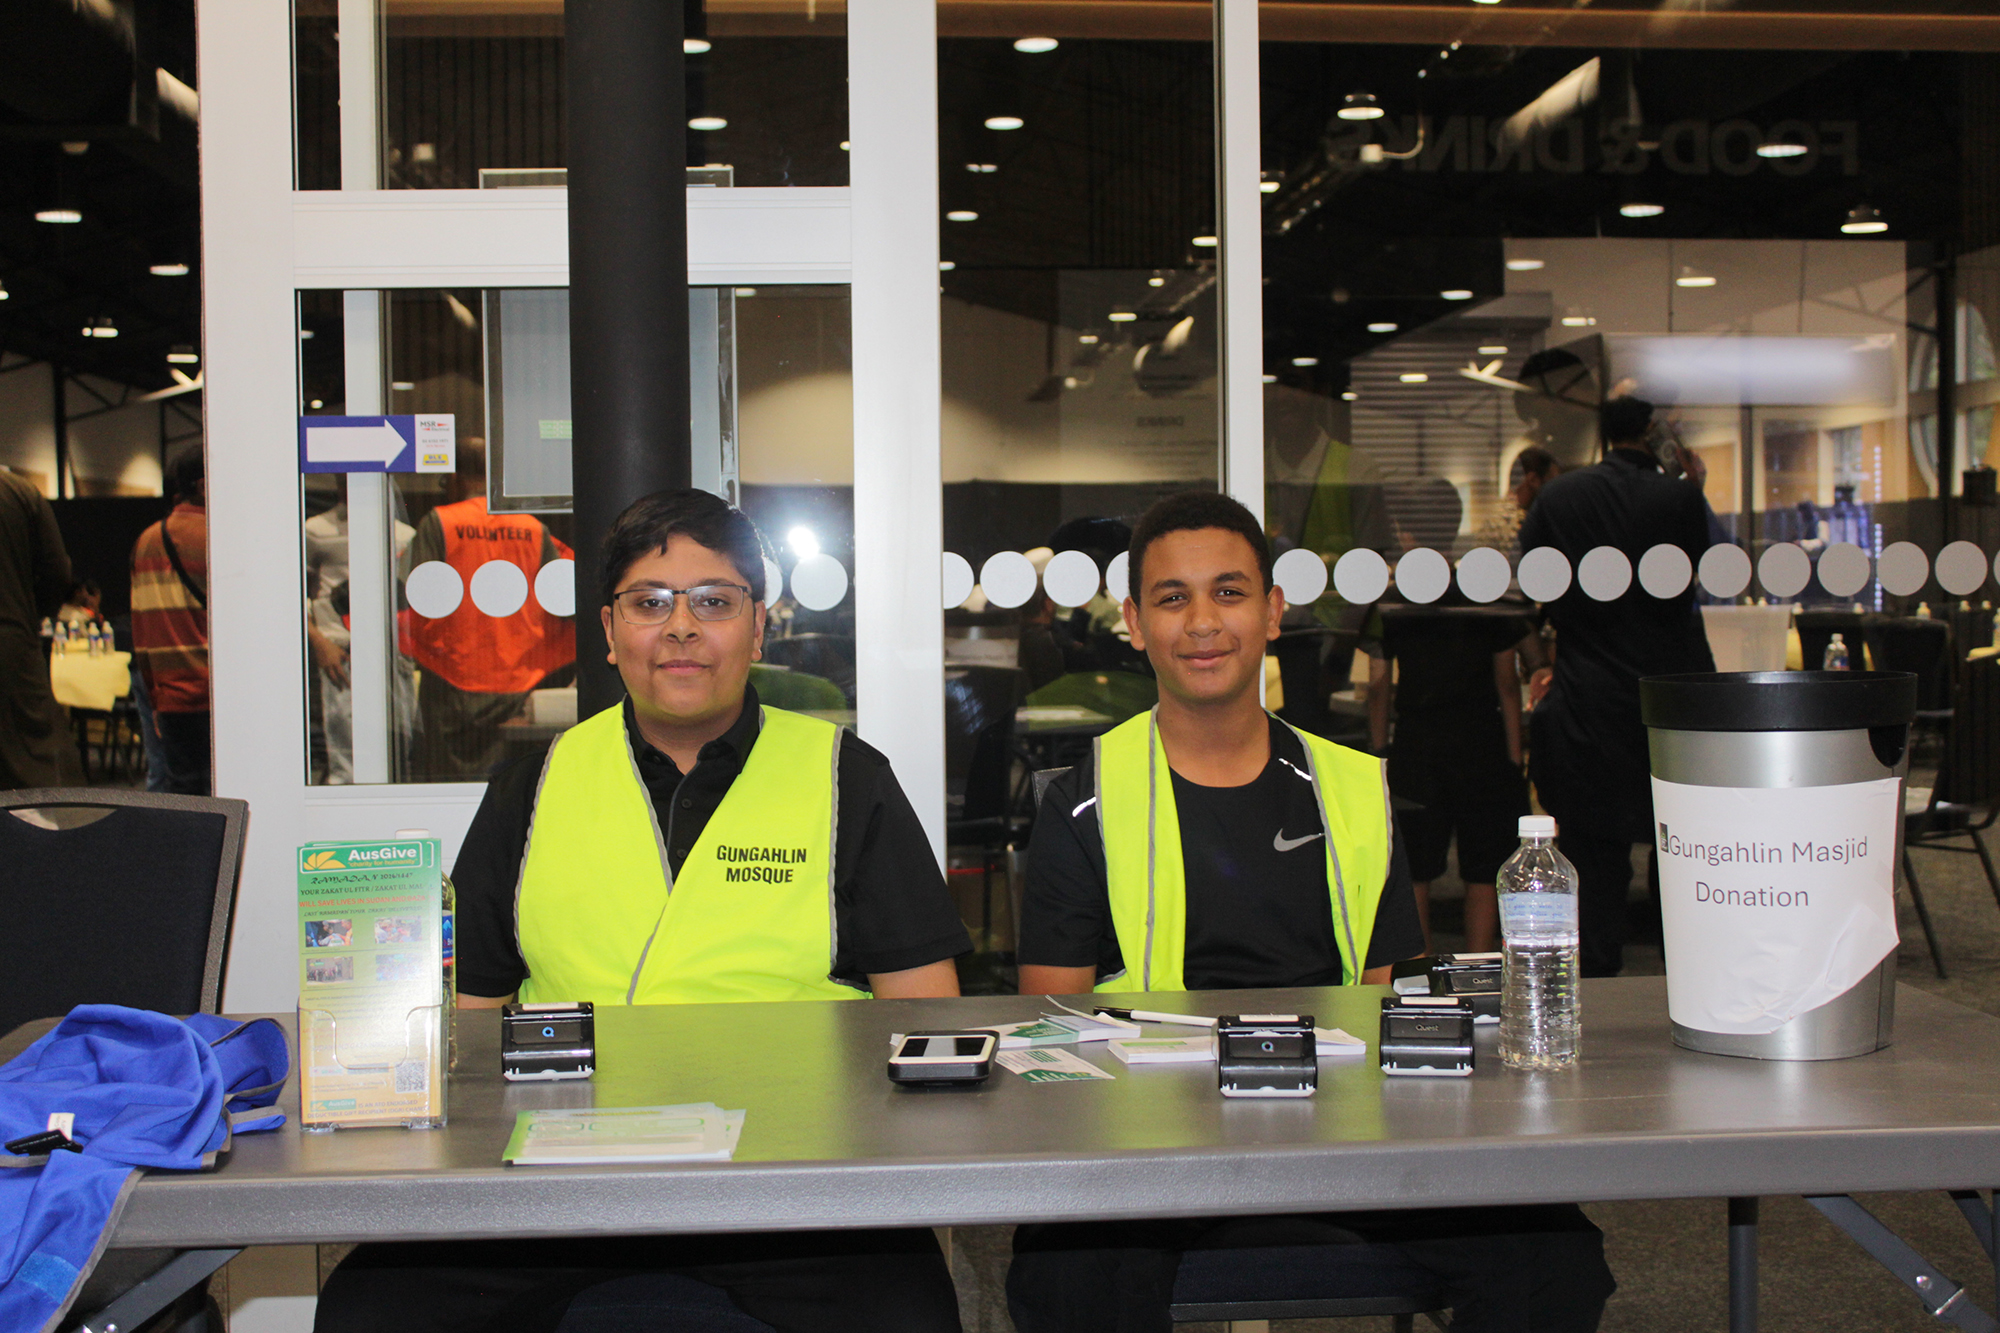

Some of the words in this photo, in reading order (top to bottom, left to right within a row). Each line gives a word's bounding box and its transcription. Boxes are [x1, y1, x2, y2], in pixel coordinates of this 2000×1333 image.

[455, 525, 532, 542] VOLUNTEER
[348, 847, 417, 861] AusGive
[717, 845, 807, 863] GUNGAHLIN
[1669, 834, 1782, 866] Gungahlin
[1792, 836, 1868, 865] Masjid
[726, 867, 793, 884] MOSQUE
[320, 887, 343, 895] ZAKAT
[1696, 880, 1809, 907] Donation
[317, 899, 335, 907] SAVE
